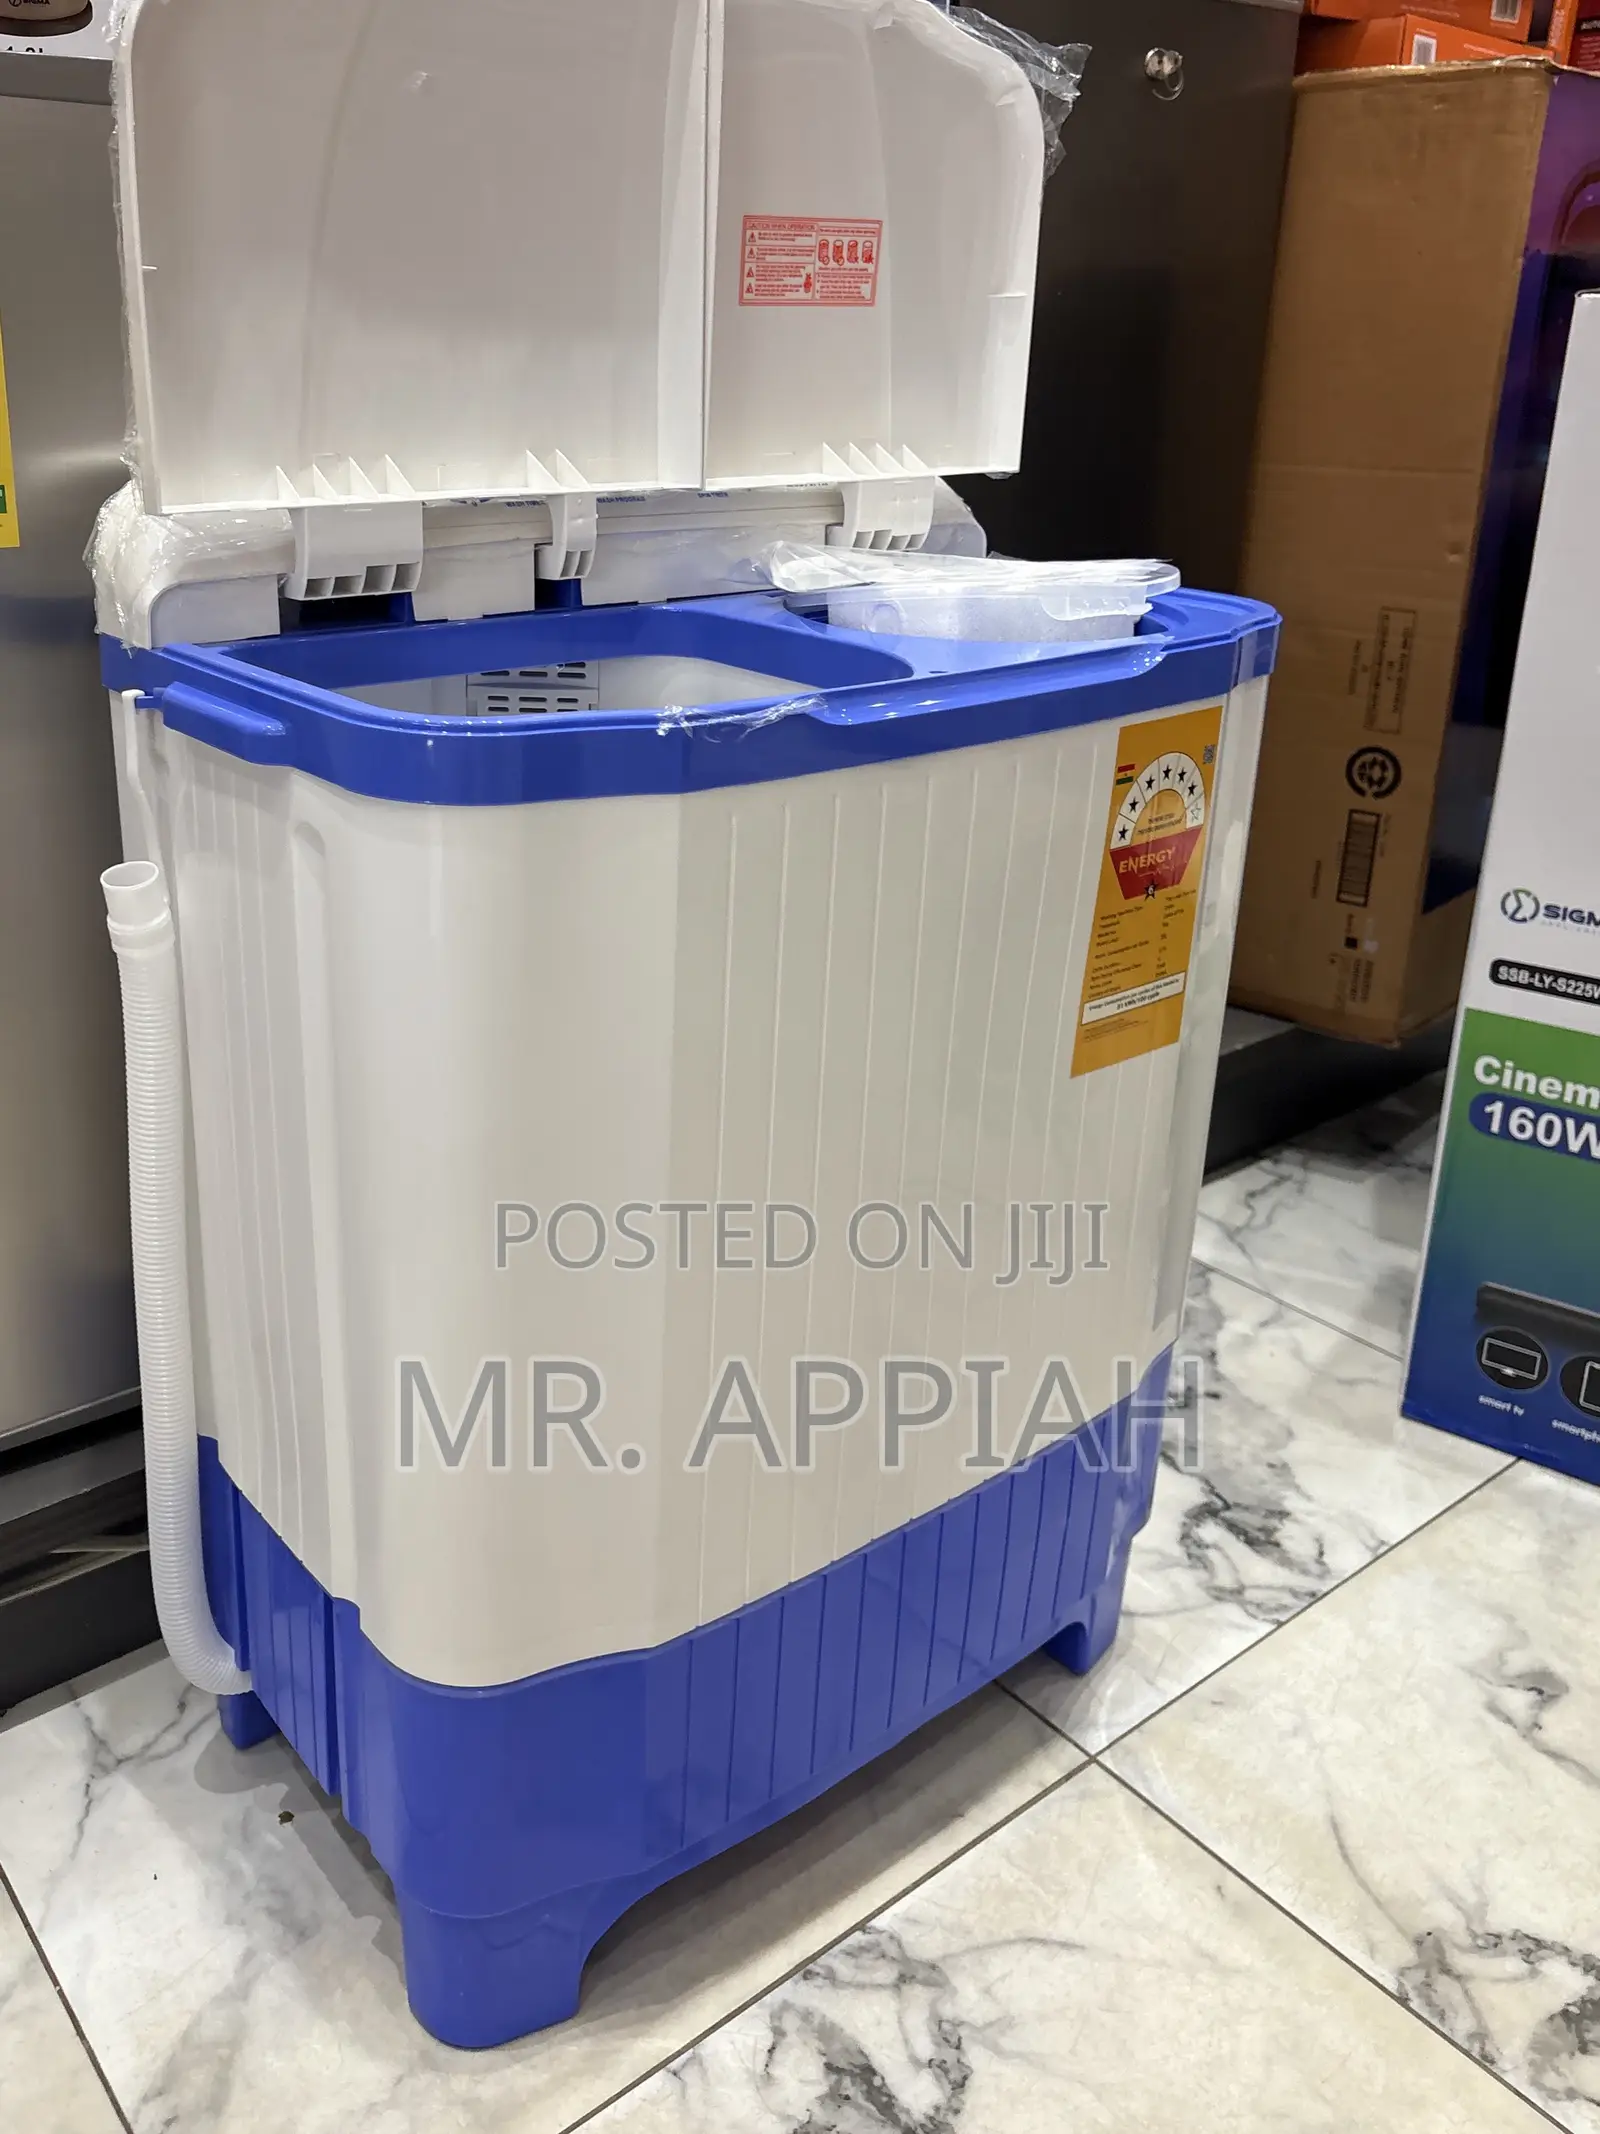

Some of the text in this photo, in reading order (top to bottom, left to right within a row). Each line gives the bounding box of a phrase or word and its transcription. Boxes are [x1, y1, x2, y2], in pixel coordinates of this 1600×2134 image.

[1119, 847, 1176, 874] ENERGY
[1147, 886, 1154, 895] 6
[1474, 1054, 1600, 1110] Cinem
[1484, 1100, 1600, 1160] 160W
[1478, 1395, 1525, 1417] smart tv
